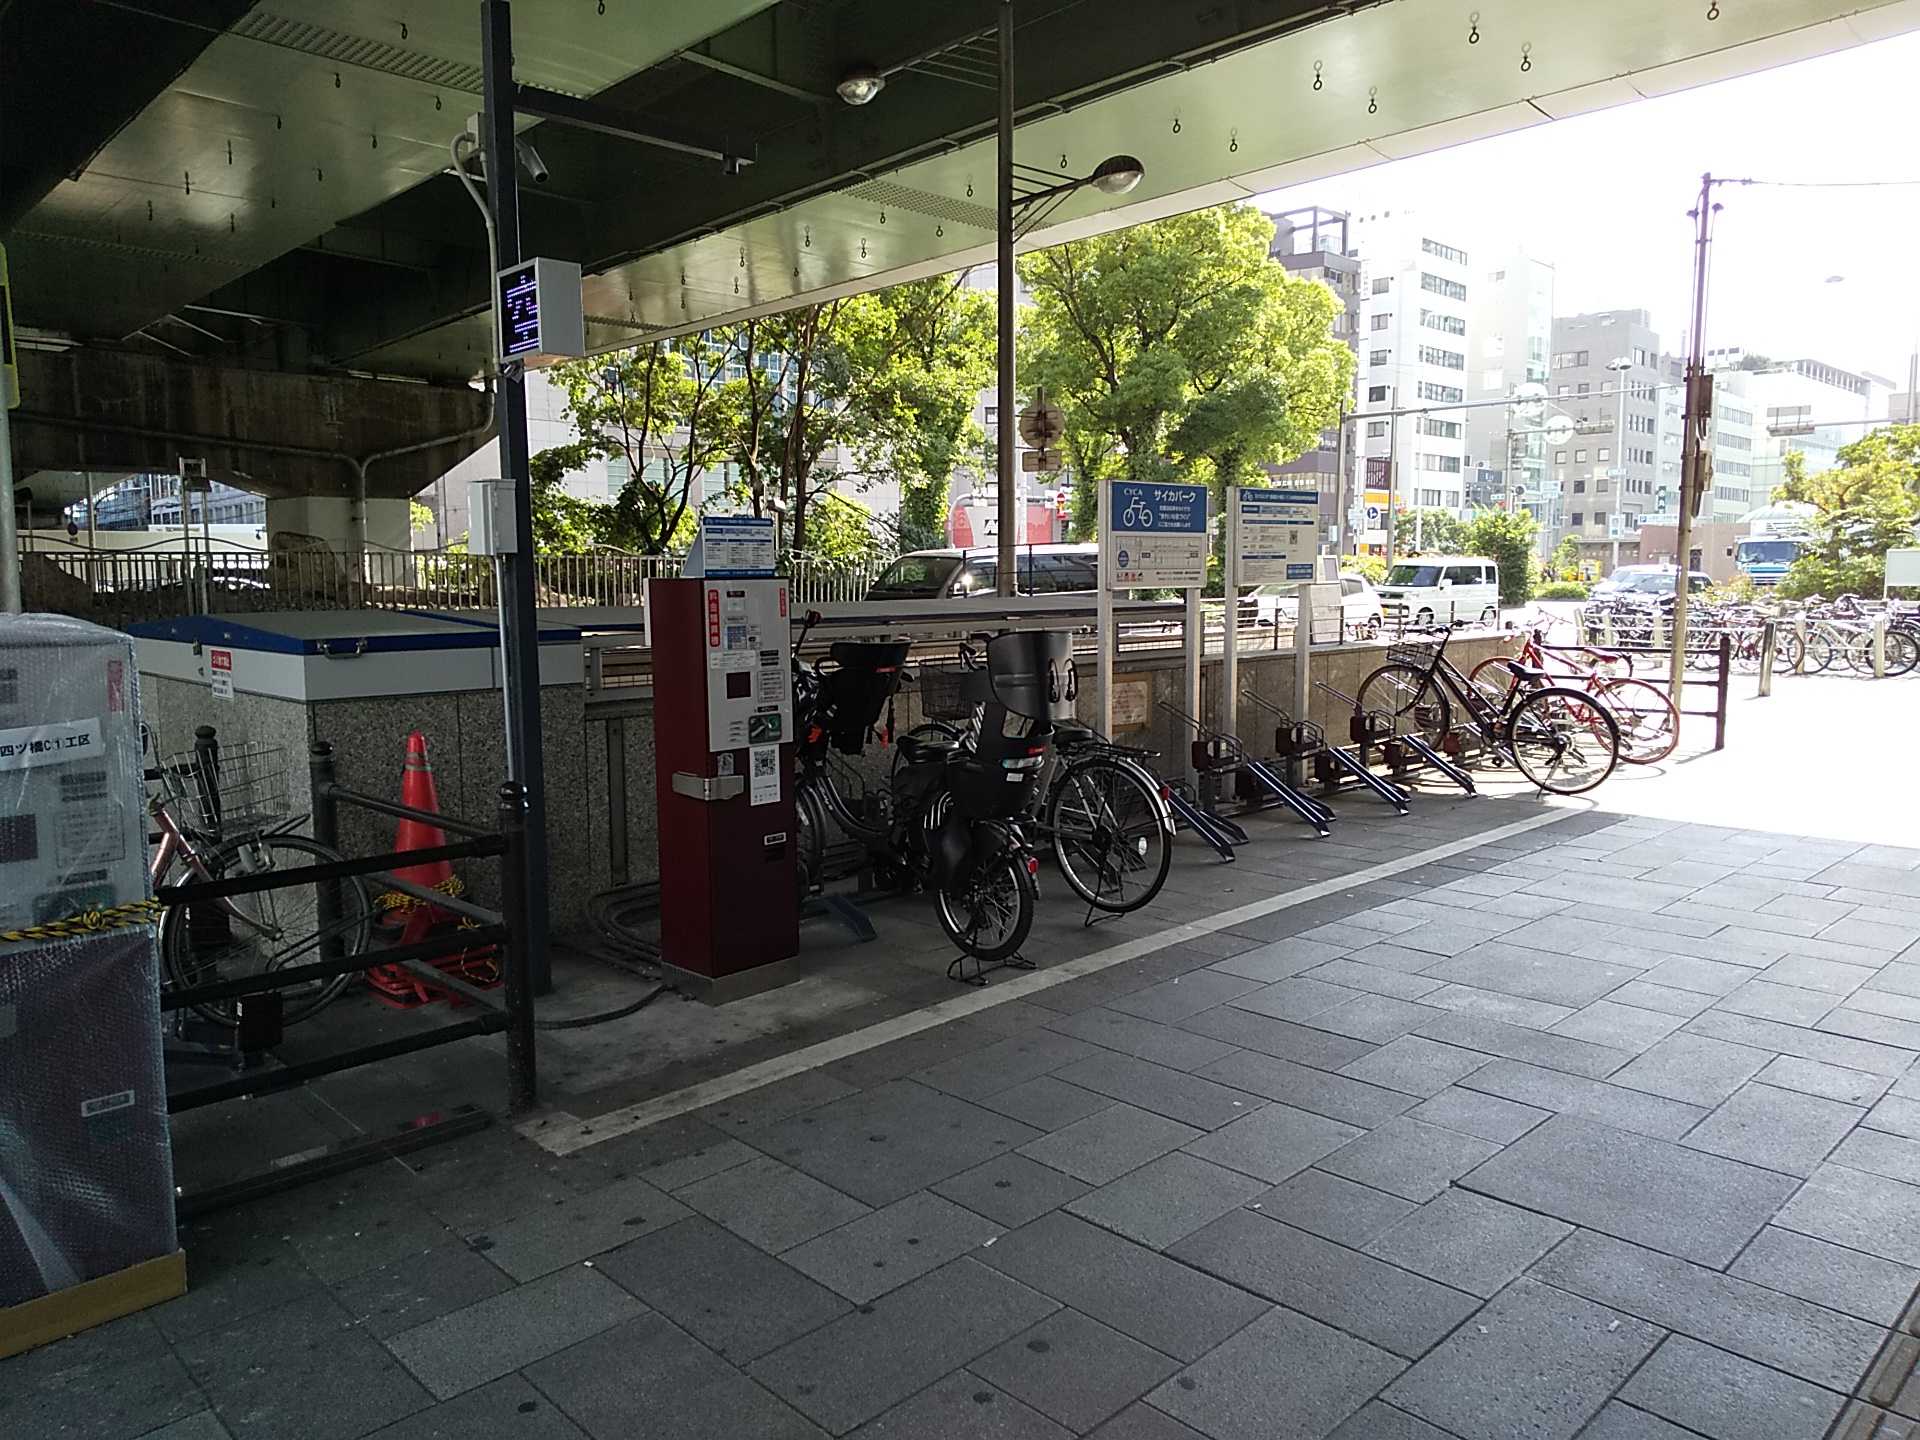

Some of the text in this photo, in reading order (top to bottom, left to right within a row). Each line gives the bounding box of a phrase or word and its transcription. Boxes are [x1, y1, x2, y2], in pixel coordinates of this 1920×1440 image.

[1123, 488, 1143, 496] CYCA
[1154, 489, 1196, 503] サイカパーク
[0, 733, 91, 757] 四ツ橋C①工区
